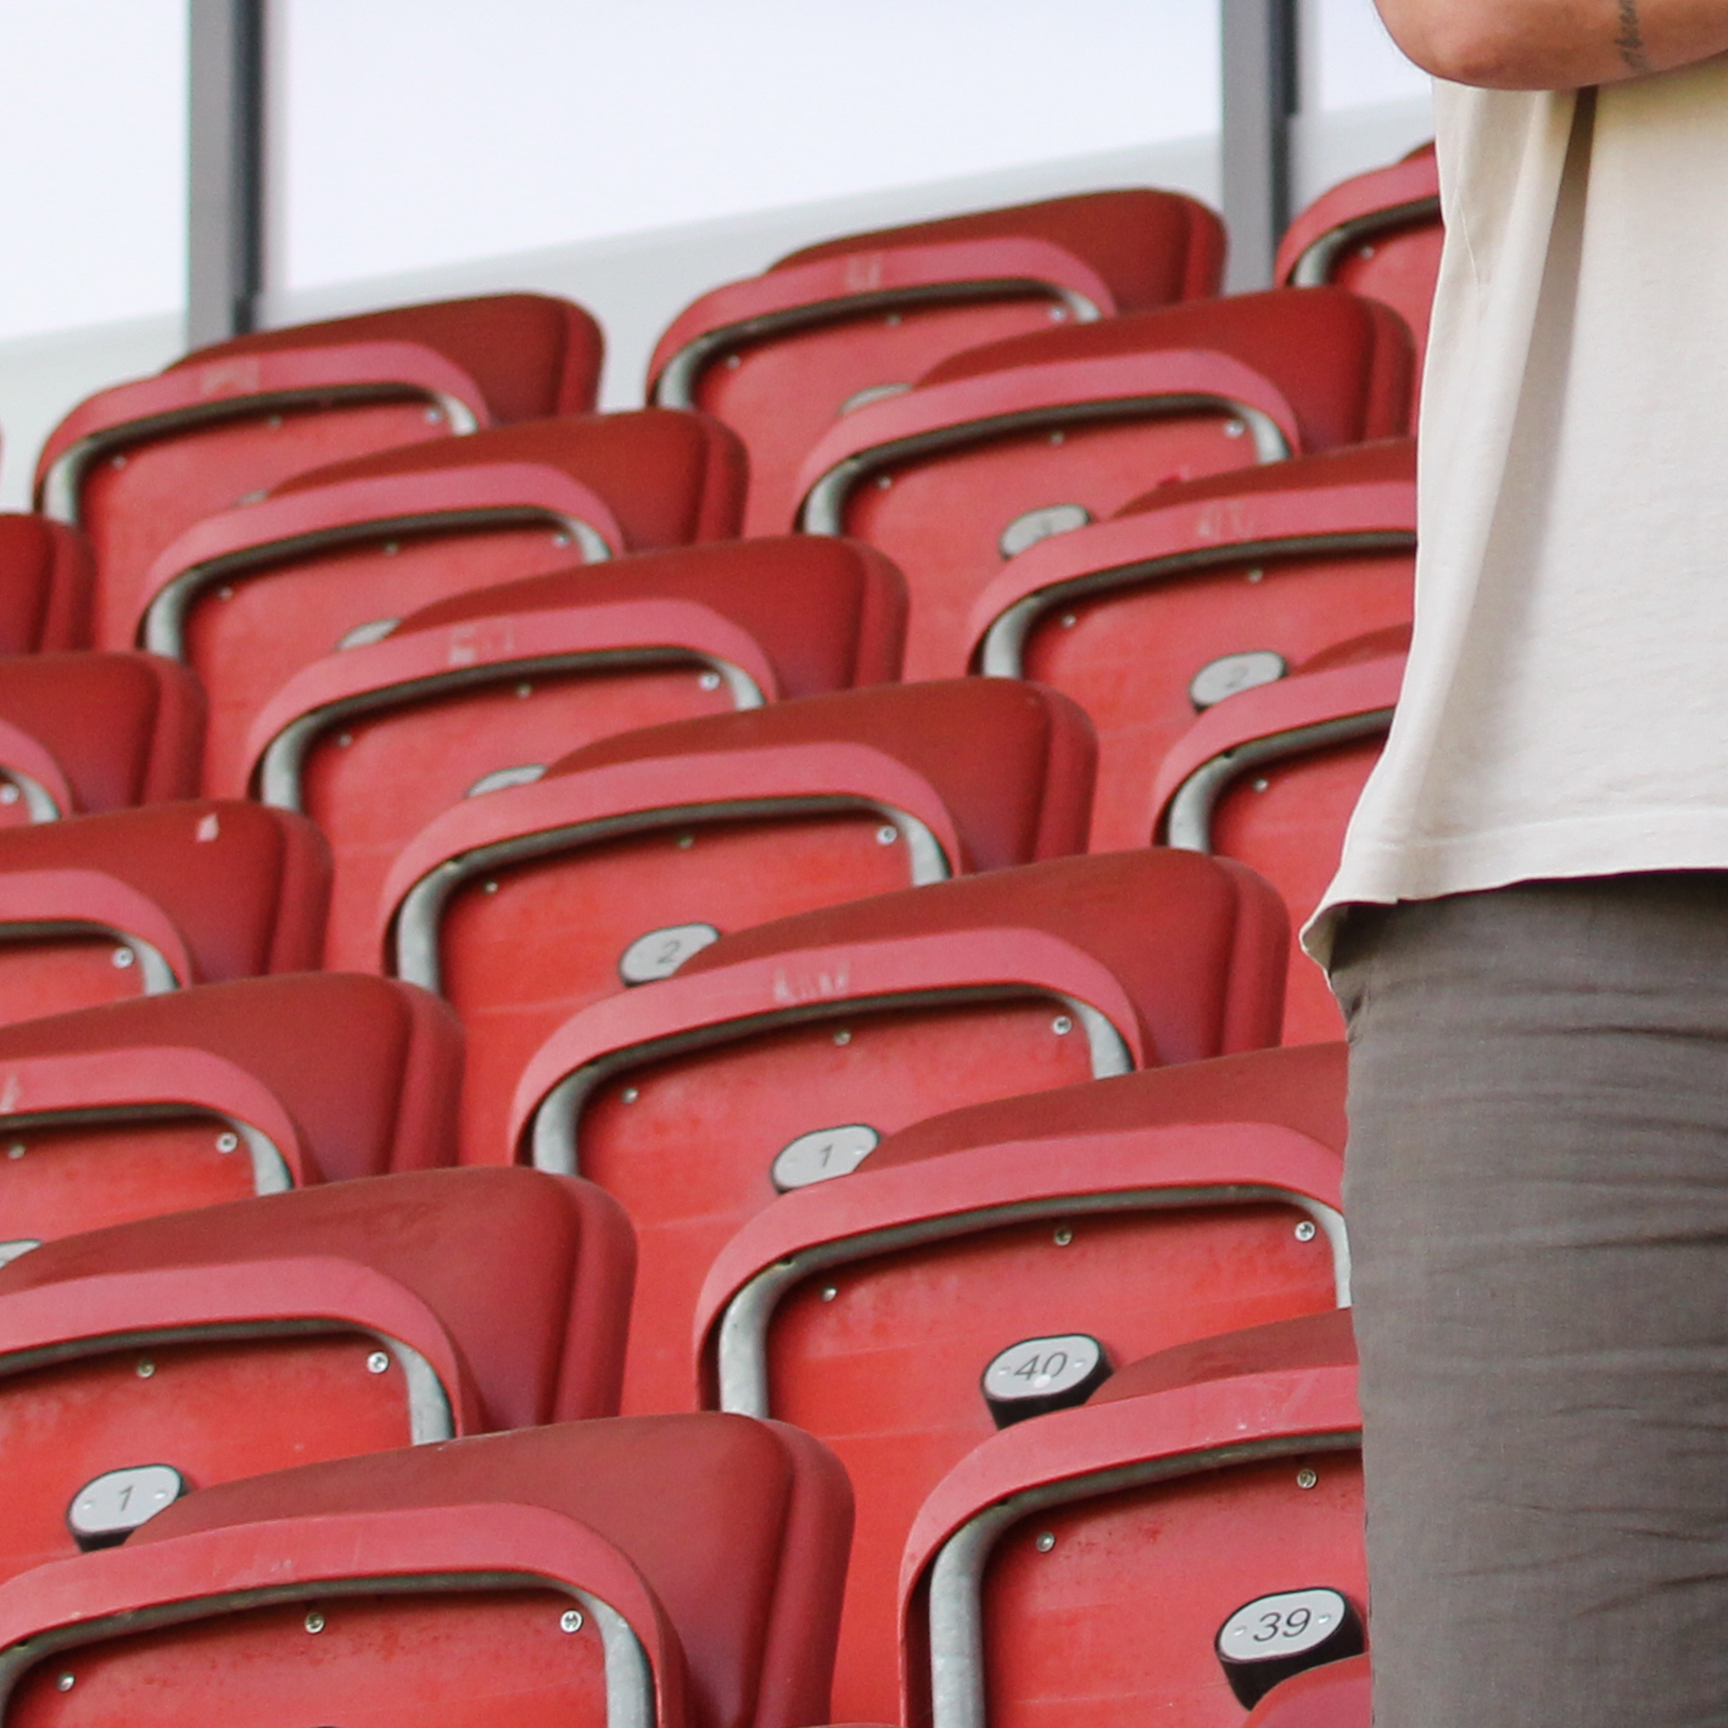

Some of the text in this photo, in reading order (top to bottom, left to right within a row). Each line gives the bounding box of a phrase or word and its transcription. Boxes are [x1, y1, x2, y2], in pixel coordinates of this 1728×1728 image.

[656, 939, 682, 965] 2
[818, 1142, 835, 1169] 1
[1013, 1351, 1068, 1381] 40
[119, 1484, 135, 1513] 1
[1252, 1607, 1312, 1642] 39
